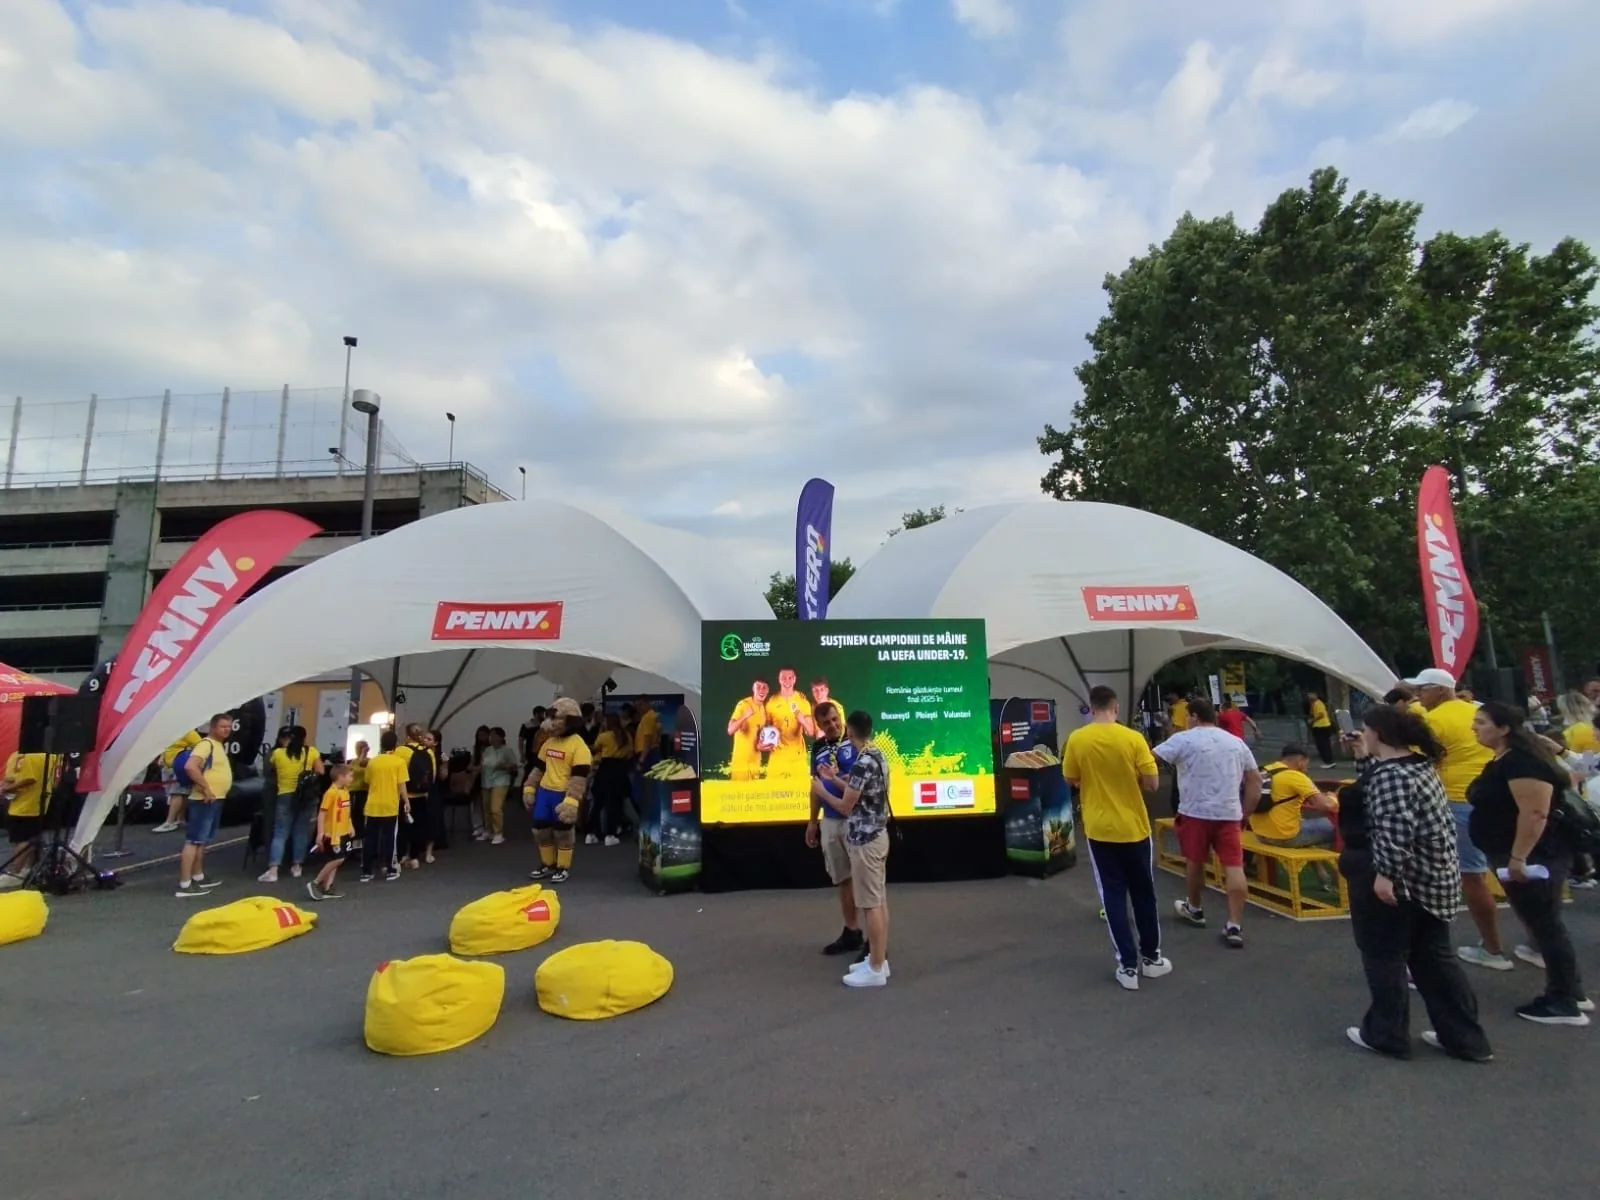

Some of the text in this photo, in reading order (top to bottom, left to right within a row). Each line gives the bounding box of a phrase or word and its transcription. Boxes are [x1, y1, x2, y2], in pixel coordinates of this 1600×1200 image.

[869, 634, 921, 646] CAMPIONII
[922, 633, 935, 645] DE
[936, 631, 968, 645] MÂINE
[878, 650, 890, 661] LA
[891, 650, 916, 661] UEFA
[89, 678, 100, 692] 9
[231, 719, 241, 732] 6
[224, 741, 241, 754] 10
[143, 796, 153, 810] 3
